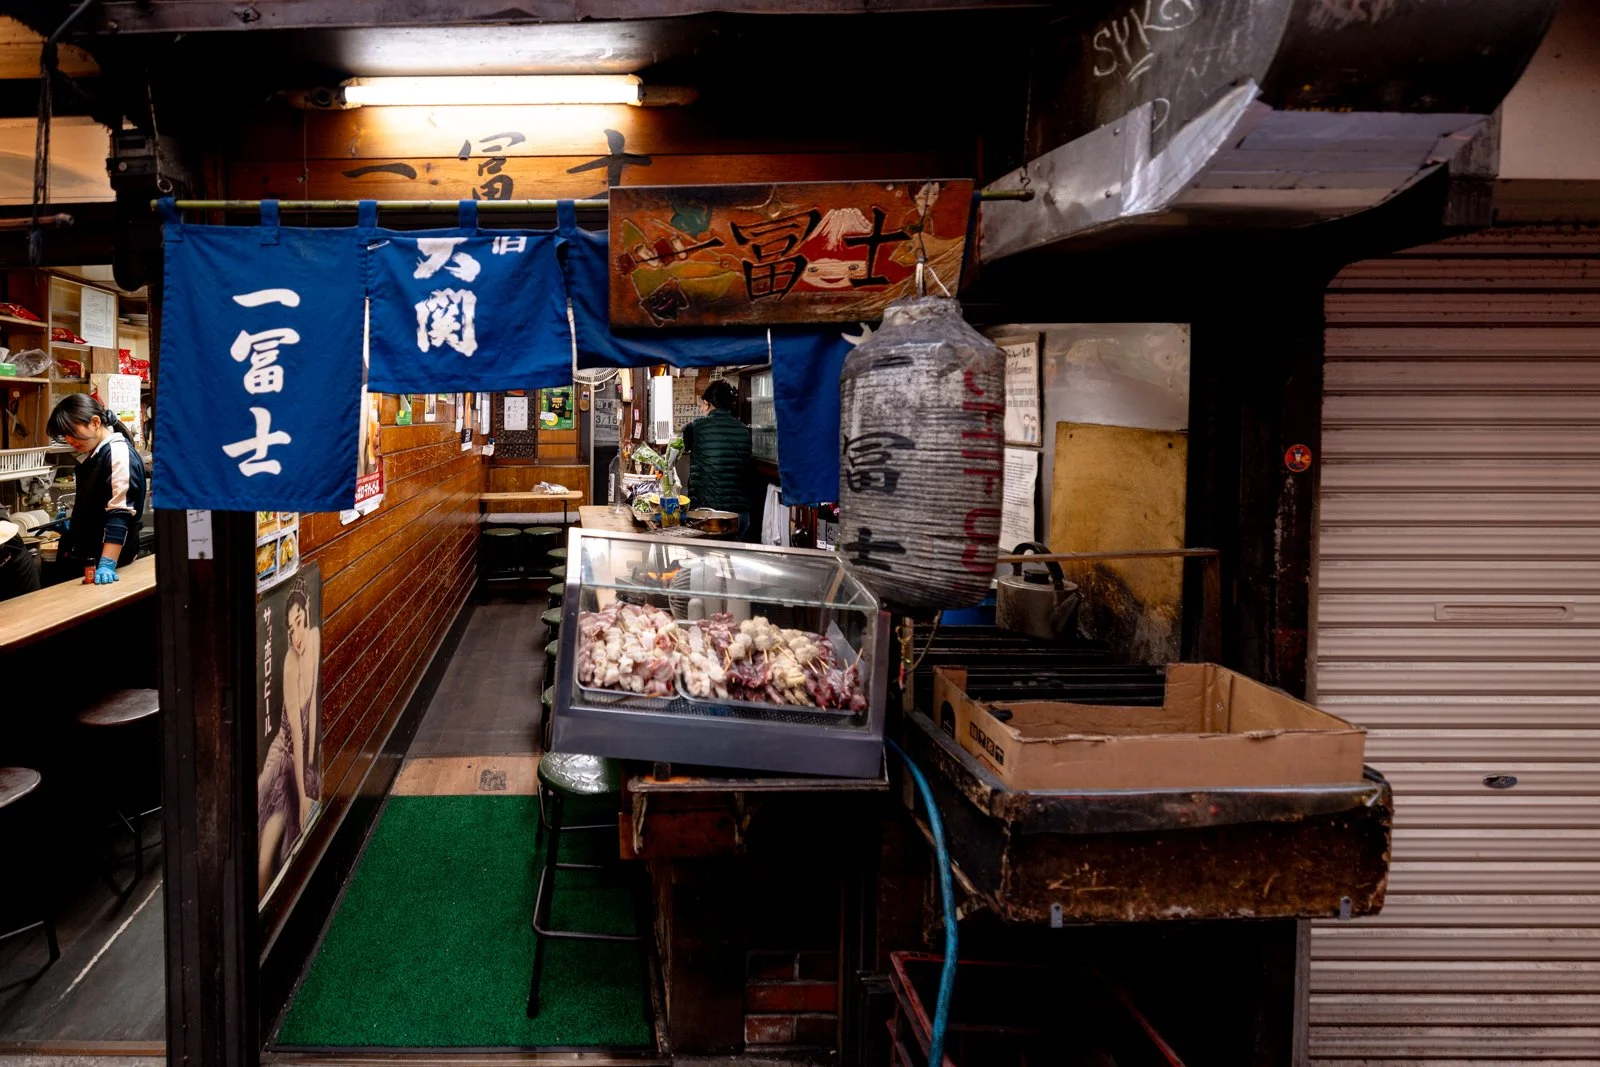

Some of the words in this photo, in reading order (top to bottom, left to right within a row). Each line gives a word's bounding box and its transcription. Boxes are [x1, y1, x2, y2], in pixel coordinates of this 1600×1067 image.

[263, 606, 273, 738] サッポロビール
